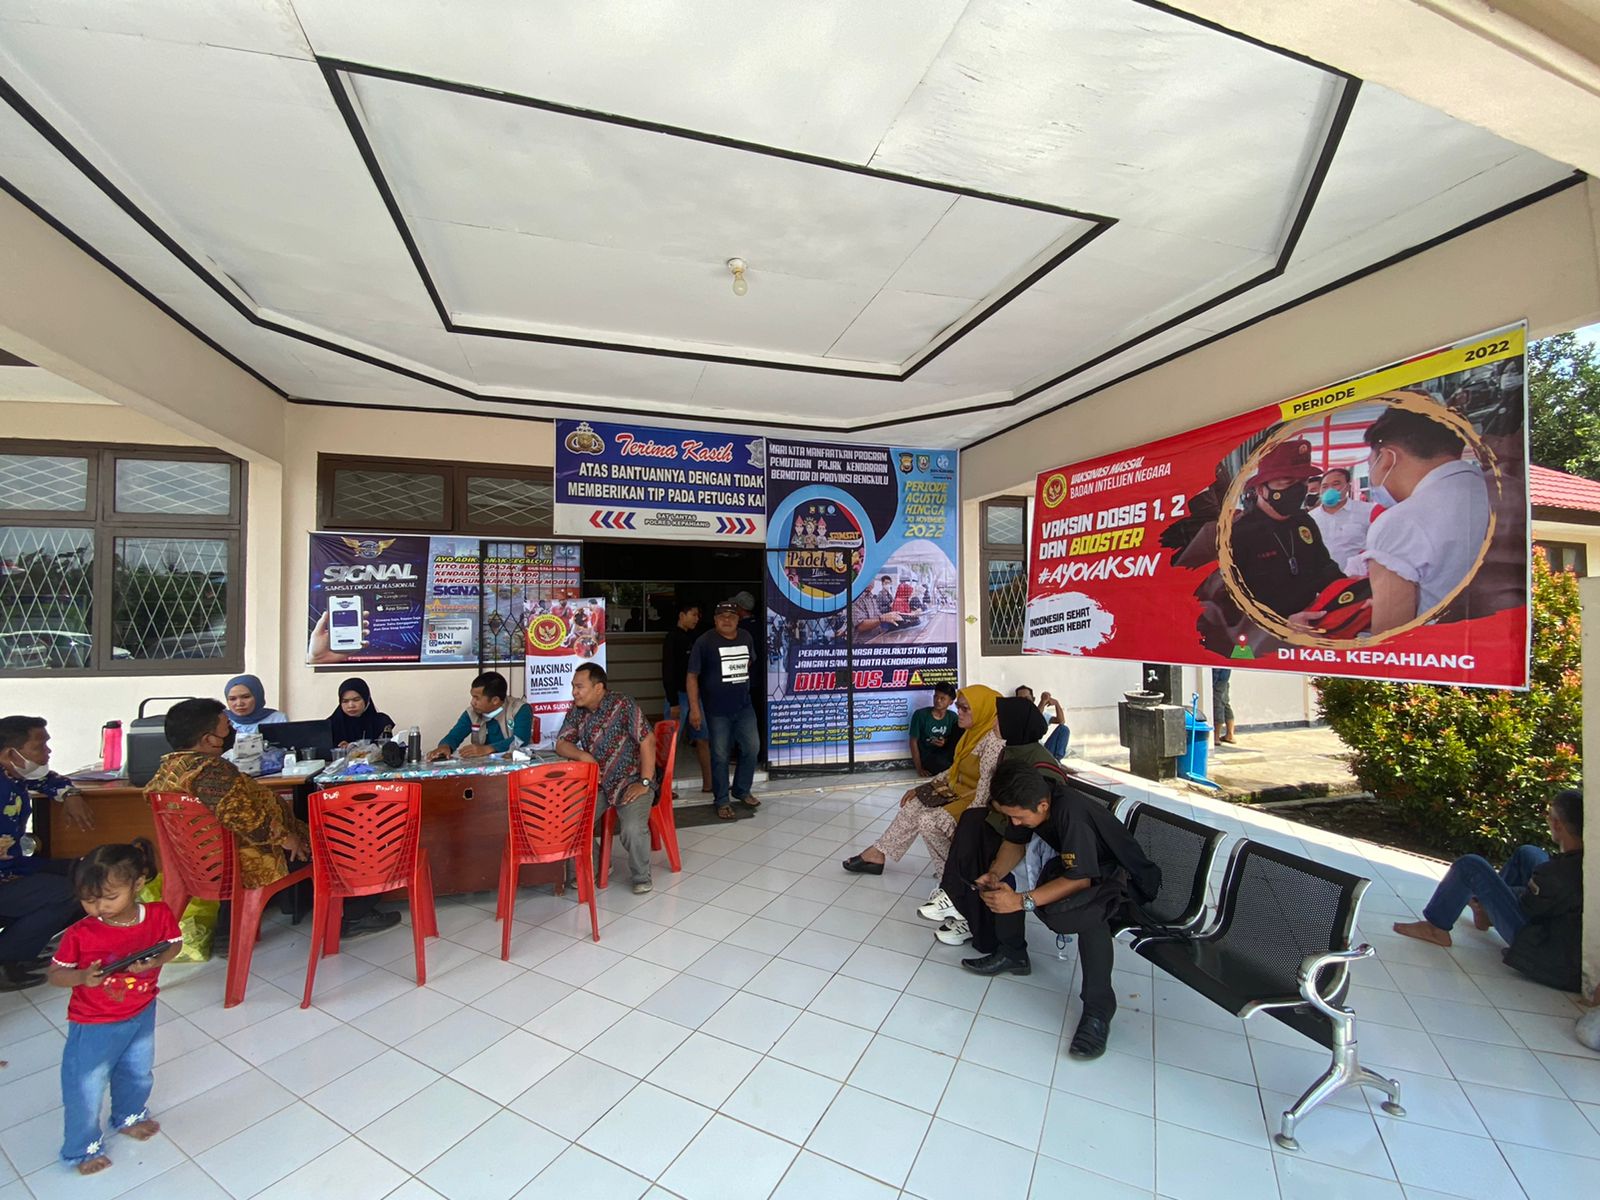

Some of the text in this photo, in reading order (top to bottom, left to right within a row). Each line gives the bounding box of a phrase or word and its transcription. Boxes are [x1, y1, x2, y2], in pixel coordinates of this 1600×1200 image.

[1464, 340, 1510, 362] 2022
[1293, 387, 1356, 414] PERIODE
[615, 432, 735, 464] Terima Kasih
[769, 444, 888, 462] MARI KITA MANFAATKAN PROGRAM
[770, 456, 888, 474] PEMUTIHAN PAJAK KENDARAAN
[1071, 456, 1145, 485] VAKSINASI MASSAL
[579, 462, 764, 489] ATAS BANTUANNYA DENGAN TIDAK
[770, 469, 889, 486] BERMOTOR DI PROVINSI BENGKULU
[1070, 483, 1094, 499] BADAN
[1094, 473, 1134, 494] INTELIJEN
[1135, 463, 1171, 484] NEGARA
[568, 481, 645, 500] MEMBERIKAN
[647, 487, 666, 501] TIP
[668, 490, 696, 504] PADA
[698, 491, 746, 507] PETUGAS
[905, 481, 948, 492] PERIODE
[905, 492, 948, 504] AGUSTUS
[905, 504, 944, 515] HINGGA
[1042, 494, 1186, 539] VAKSIN DOSIS 1, 2
[645, 518, 710, 528] POLRES KEPAHIANG
[904, 524, 945, 538] 2022
[1039, 527, 1145, 560] DAN BOOSTER
[789, 551, 828, 568] Padek
[322, 563, 418, 583] SIGNAL
[1038, 552, 1162, 589] #AYOVAKSIN
[382, 582, 416, 590] NASIONAL
[1030, 606, 1090, 627] INDONESIA SEHAT
[438, 632, 454, 640] BNI
[1030, 618, 1092, 638] INDONESIA HEBAT
[873, 648, 907, 656] BERLAKU
[907, 646, 926, 654] STNK
[928, 646, 948, 654] ANDA
[1277, 648, 1476, 670] DI KAB. KEPAHIANG
[530, 663, 572, 675] VAKSINASI
[794, 660, 828, 668] JANGAN
[860, 658, 881, 666] DATA
[882, 657, 926, 666] KENDARAAN
[927, 656, 948, 664] ANDA
[530, 676, 564, 688] MASSAL
[534, 704, 552, 712] SAYA
